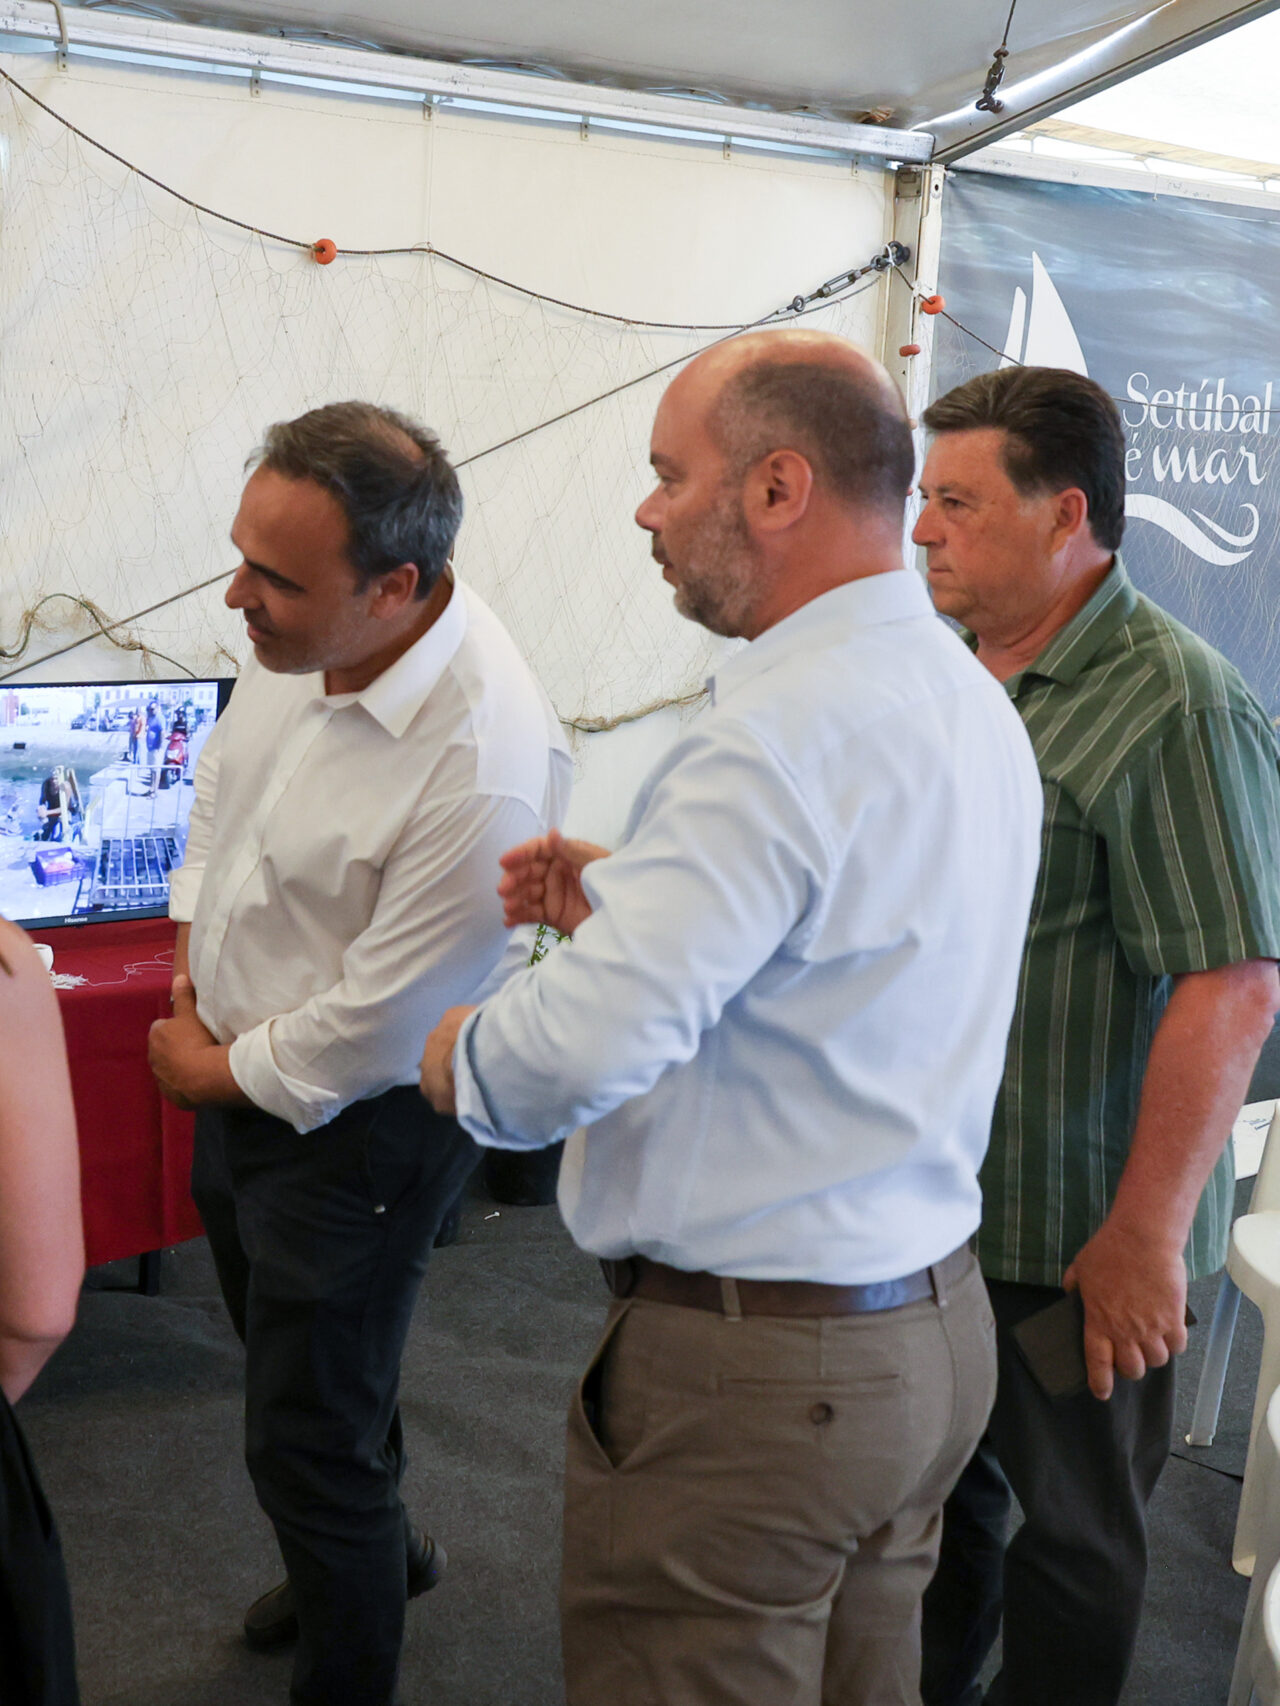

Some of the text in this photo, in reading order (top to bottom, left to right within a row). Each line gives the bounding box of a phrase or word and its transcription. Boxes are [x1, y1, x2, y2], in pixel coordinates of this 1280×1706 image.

[1123, 372, 1272, 434] Setúbal
[1125, 432, 1268, 485] é mar
